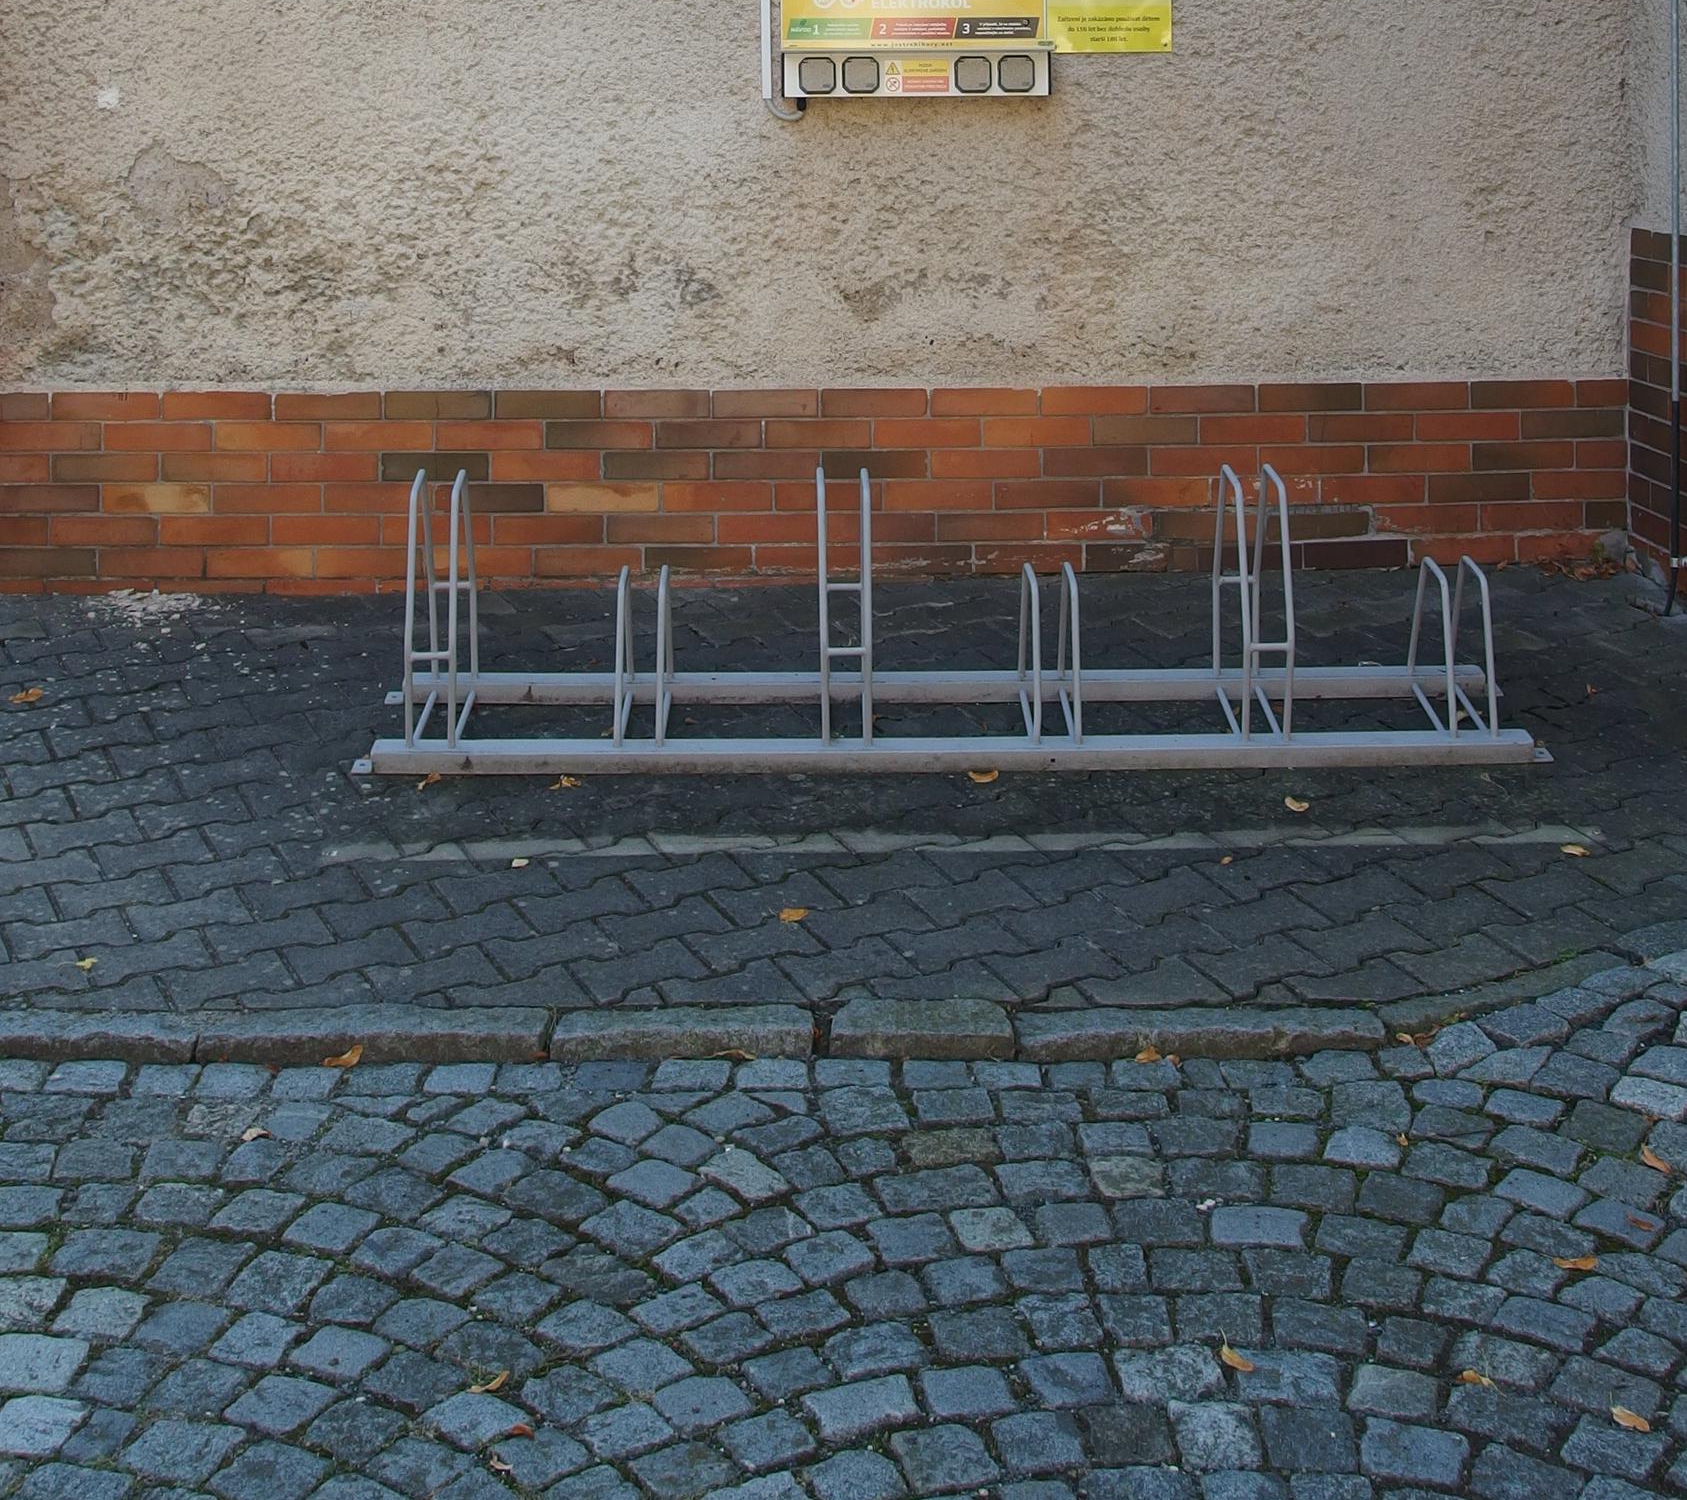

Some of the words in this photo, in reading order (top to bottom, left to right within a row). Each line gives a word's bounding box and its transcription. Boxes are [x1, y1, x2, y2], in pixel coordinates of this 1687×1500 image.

[813, 24, 820, 35] 1
[879, 23, 887, 35] 2
[962, 23, 970, 34] 3
